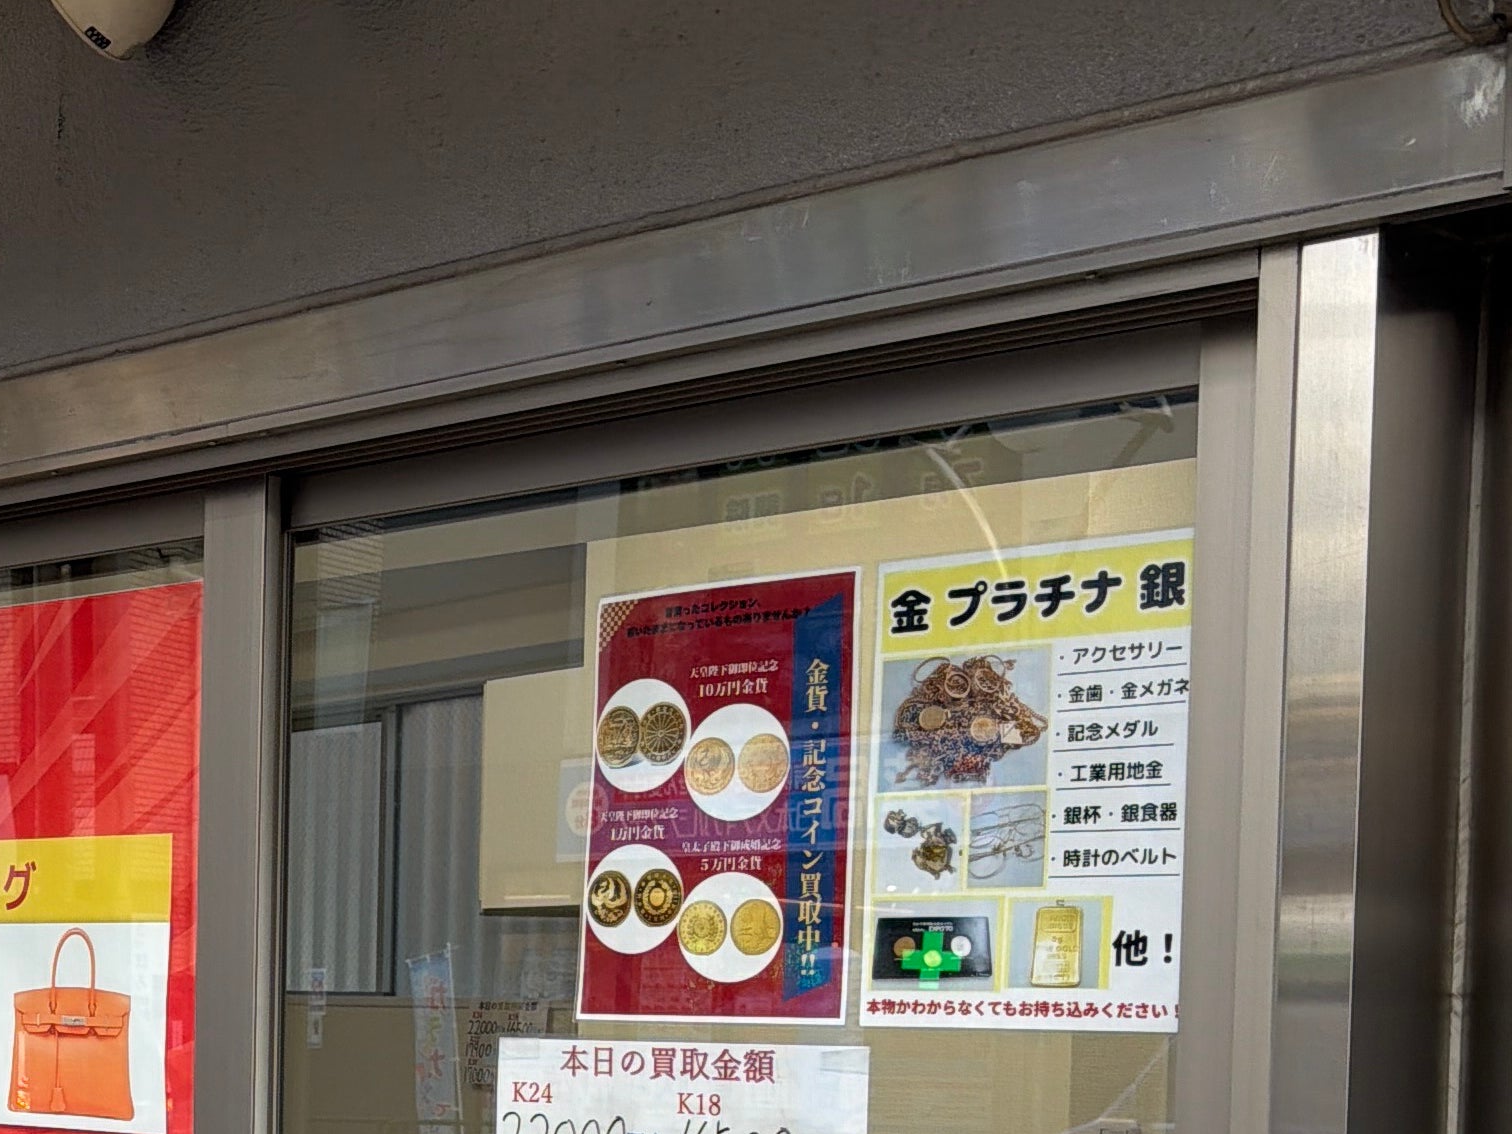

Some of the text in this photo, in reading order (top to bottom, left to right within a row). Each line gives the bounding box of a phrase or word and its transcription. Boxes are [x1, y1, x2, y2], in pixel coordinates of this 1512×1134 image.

[891, 562, 1187, 634] 金 プラチナ 銀
[698, 678, 768, 698] 10万円金貨
[700, 856, 762, 871] 5万円金貨
[560, 1045, 776, 1084] 本日の買取金額
[512, 1081, 553, 1103] K24
[677, 1092, 722, 1116] K18
